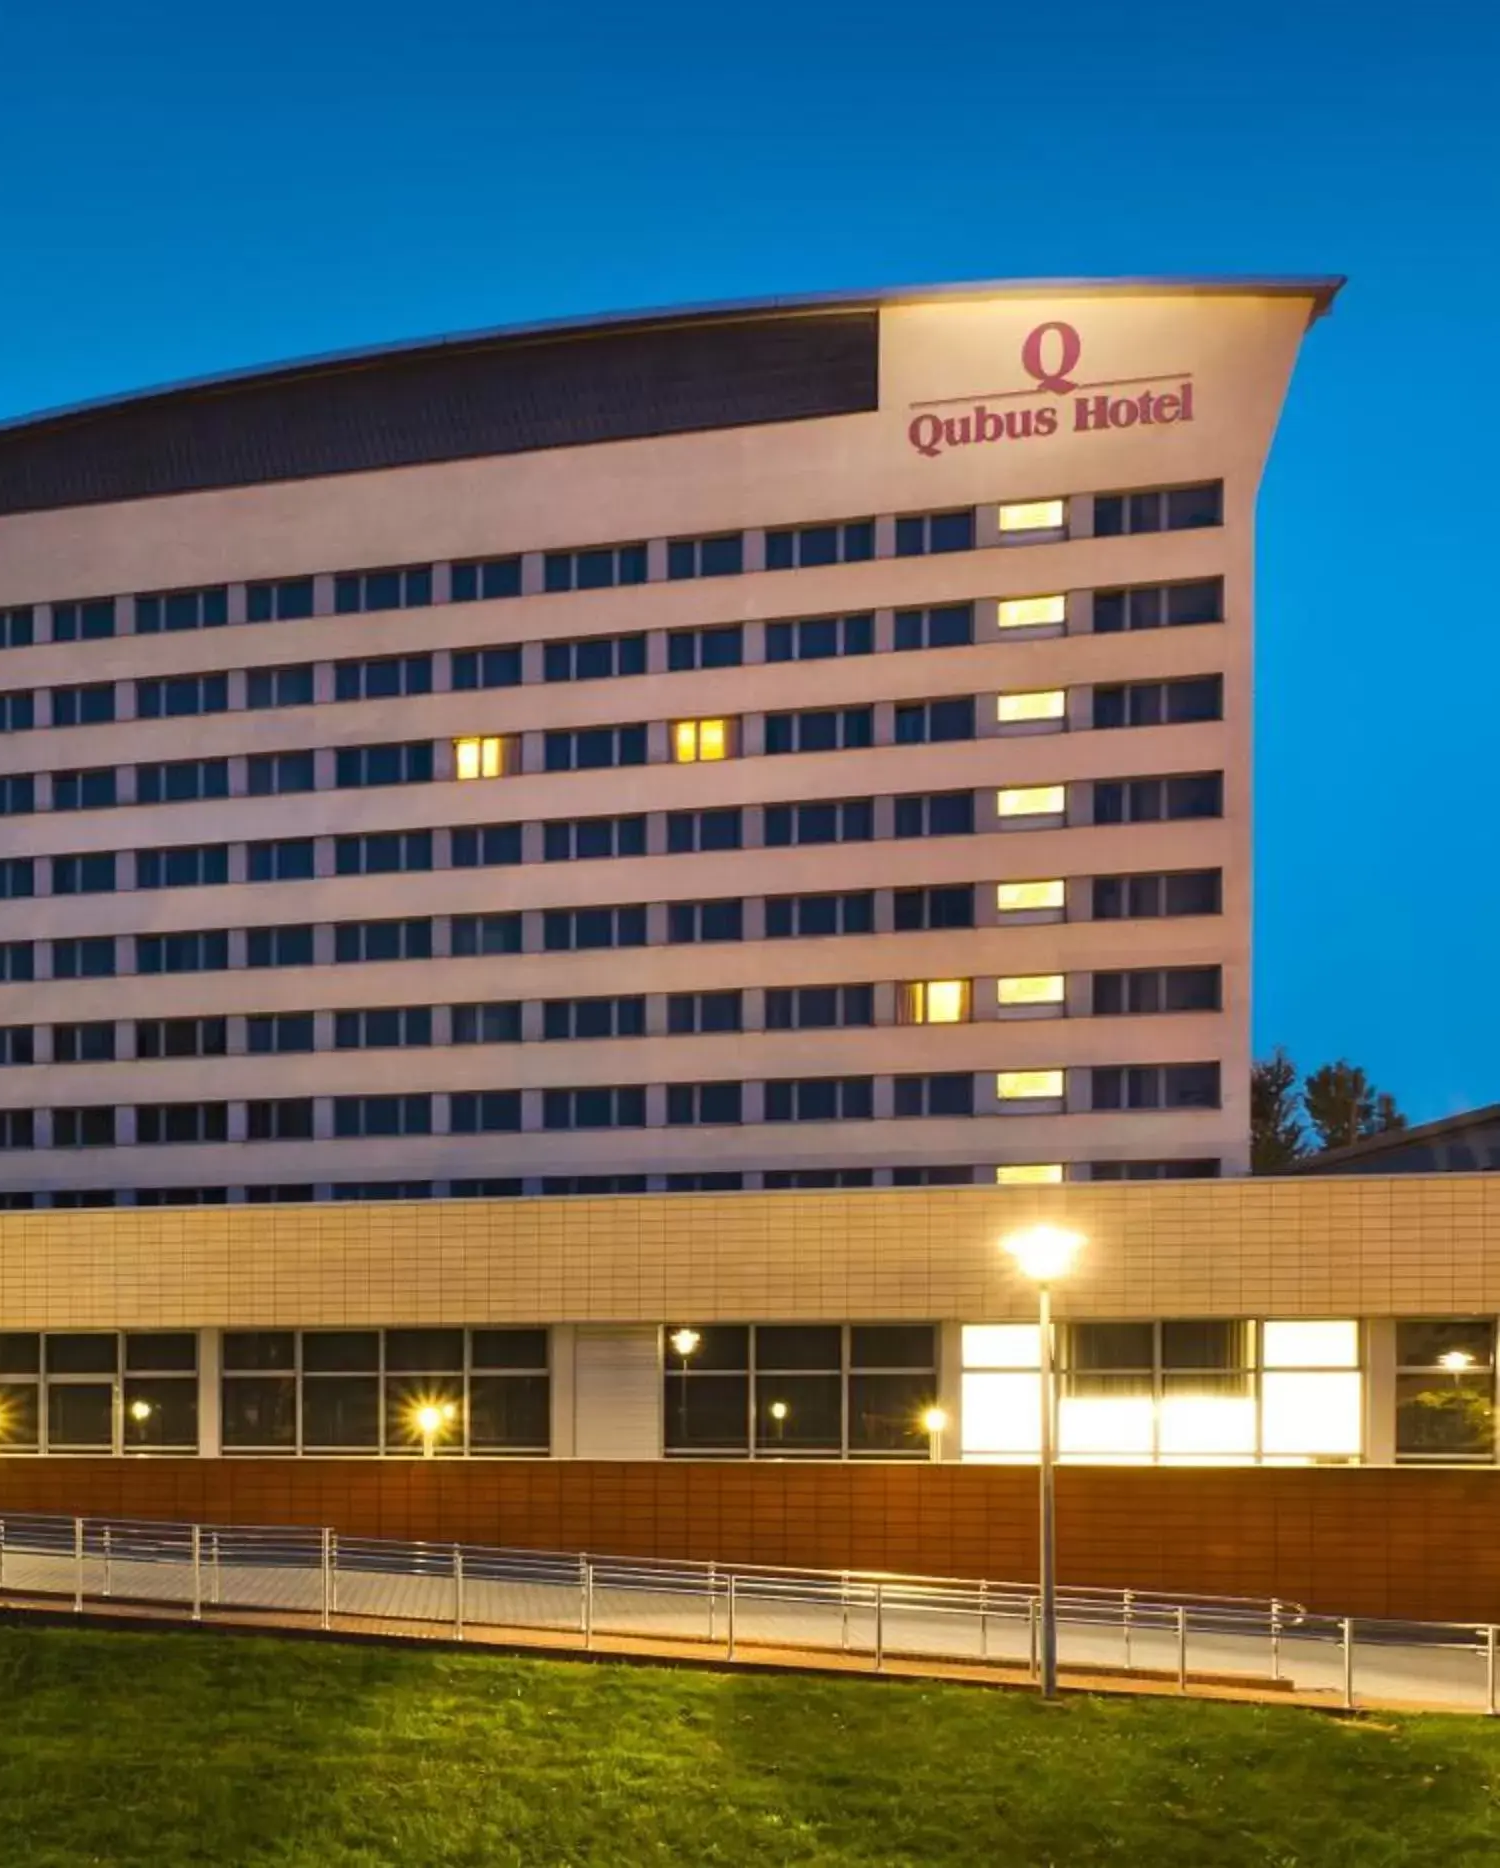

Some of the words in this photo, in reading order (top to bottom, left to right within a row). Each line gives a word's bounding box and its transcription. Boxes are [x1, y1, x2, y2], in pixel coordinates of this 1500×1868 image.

[1021, 321, 1081, 395] Q
[908, 405, 1058, 457] Qubus
[1073, 383, 1194, 432] Hotel
